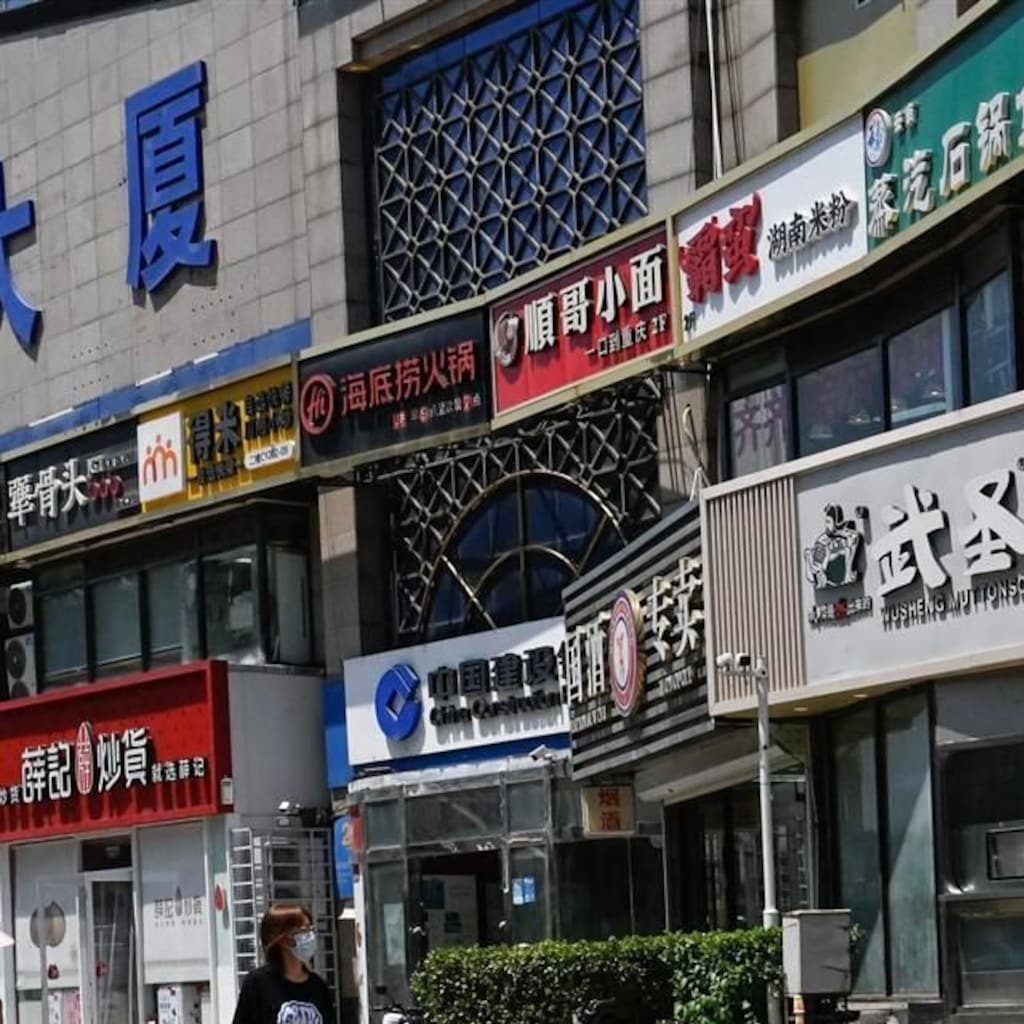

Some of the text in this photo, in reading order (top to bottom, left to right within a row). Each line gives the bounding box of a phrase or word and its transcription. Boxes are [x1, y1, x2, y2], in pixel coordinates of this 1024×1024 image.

[767, 189, 853, 261] 湖南米粉
[340, 340, 476, 415] 海底捞火锅
[880, 595, 945, 622] WUSHENG
[151, 757, 205, 783] 就选薛记
